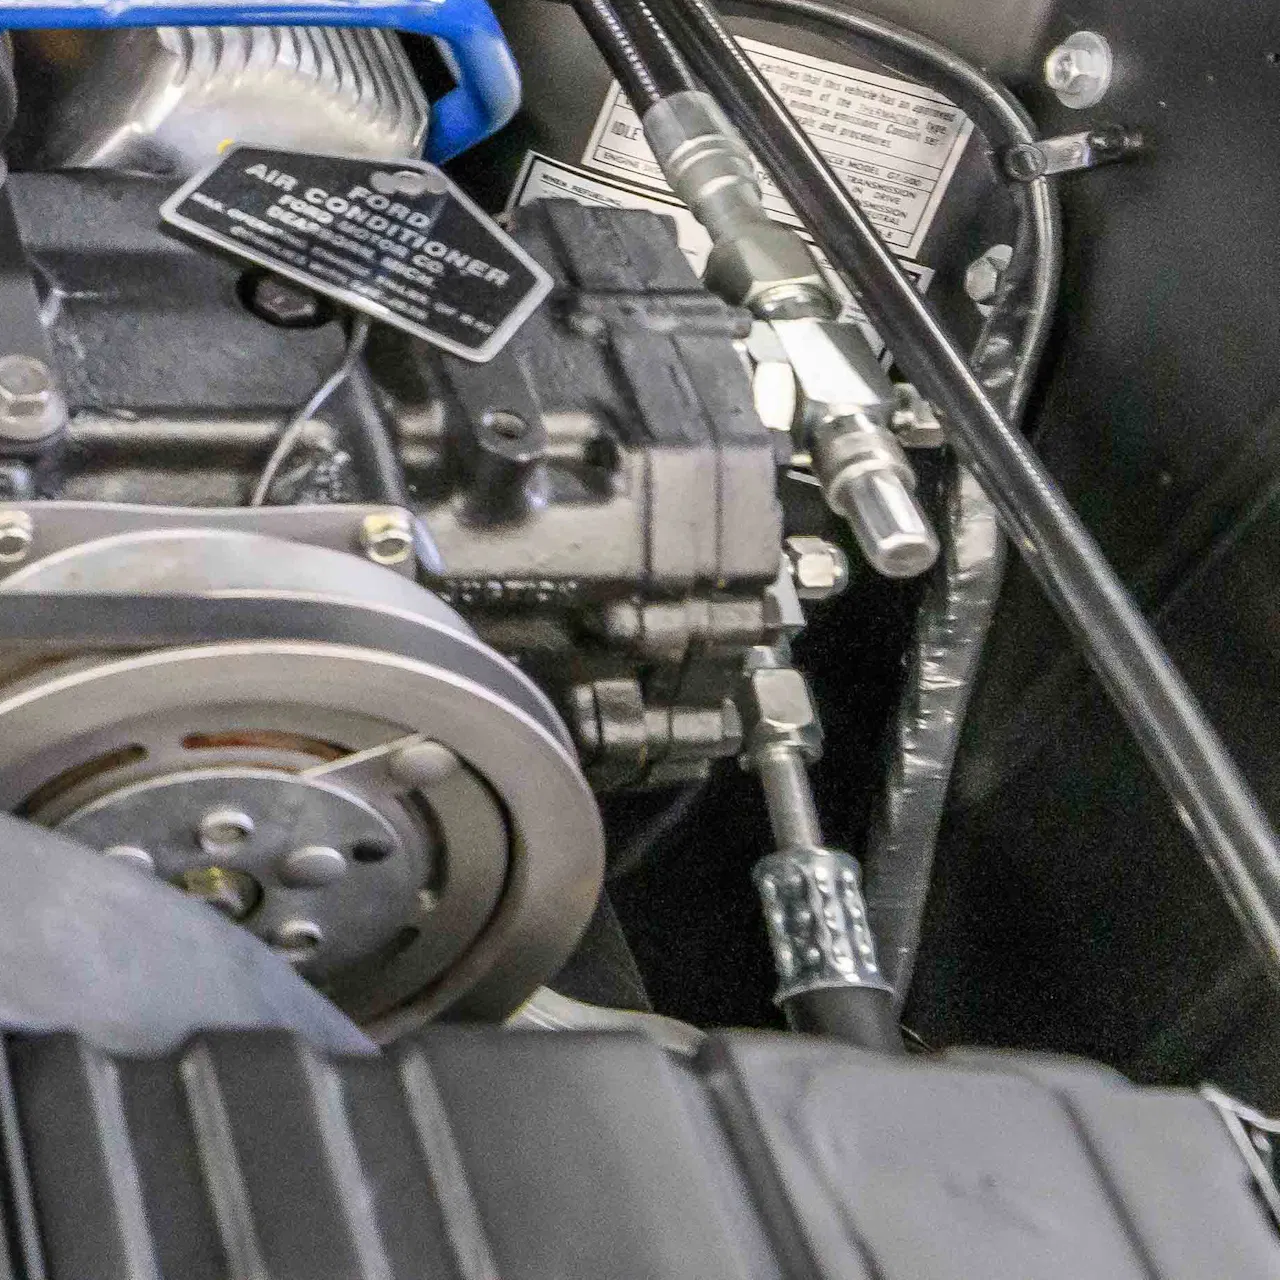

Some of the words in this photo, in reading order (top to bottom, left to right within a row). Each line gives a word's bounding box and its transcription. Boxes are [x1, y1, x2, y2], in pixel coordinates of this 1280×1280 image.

[610, 120, 642, 141] IDLE
[847, 160, 880, 175] MODEL
[846, 174, 916, 199] TRANSMISSION
[873, 191, 901, 205] DRIVE
[346, 184, 431, 231] FORD
[244, 160, 299, 193] AIR
[302, 185, 511, 287] CONDITIONER
